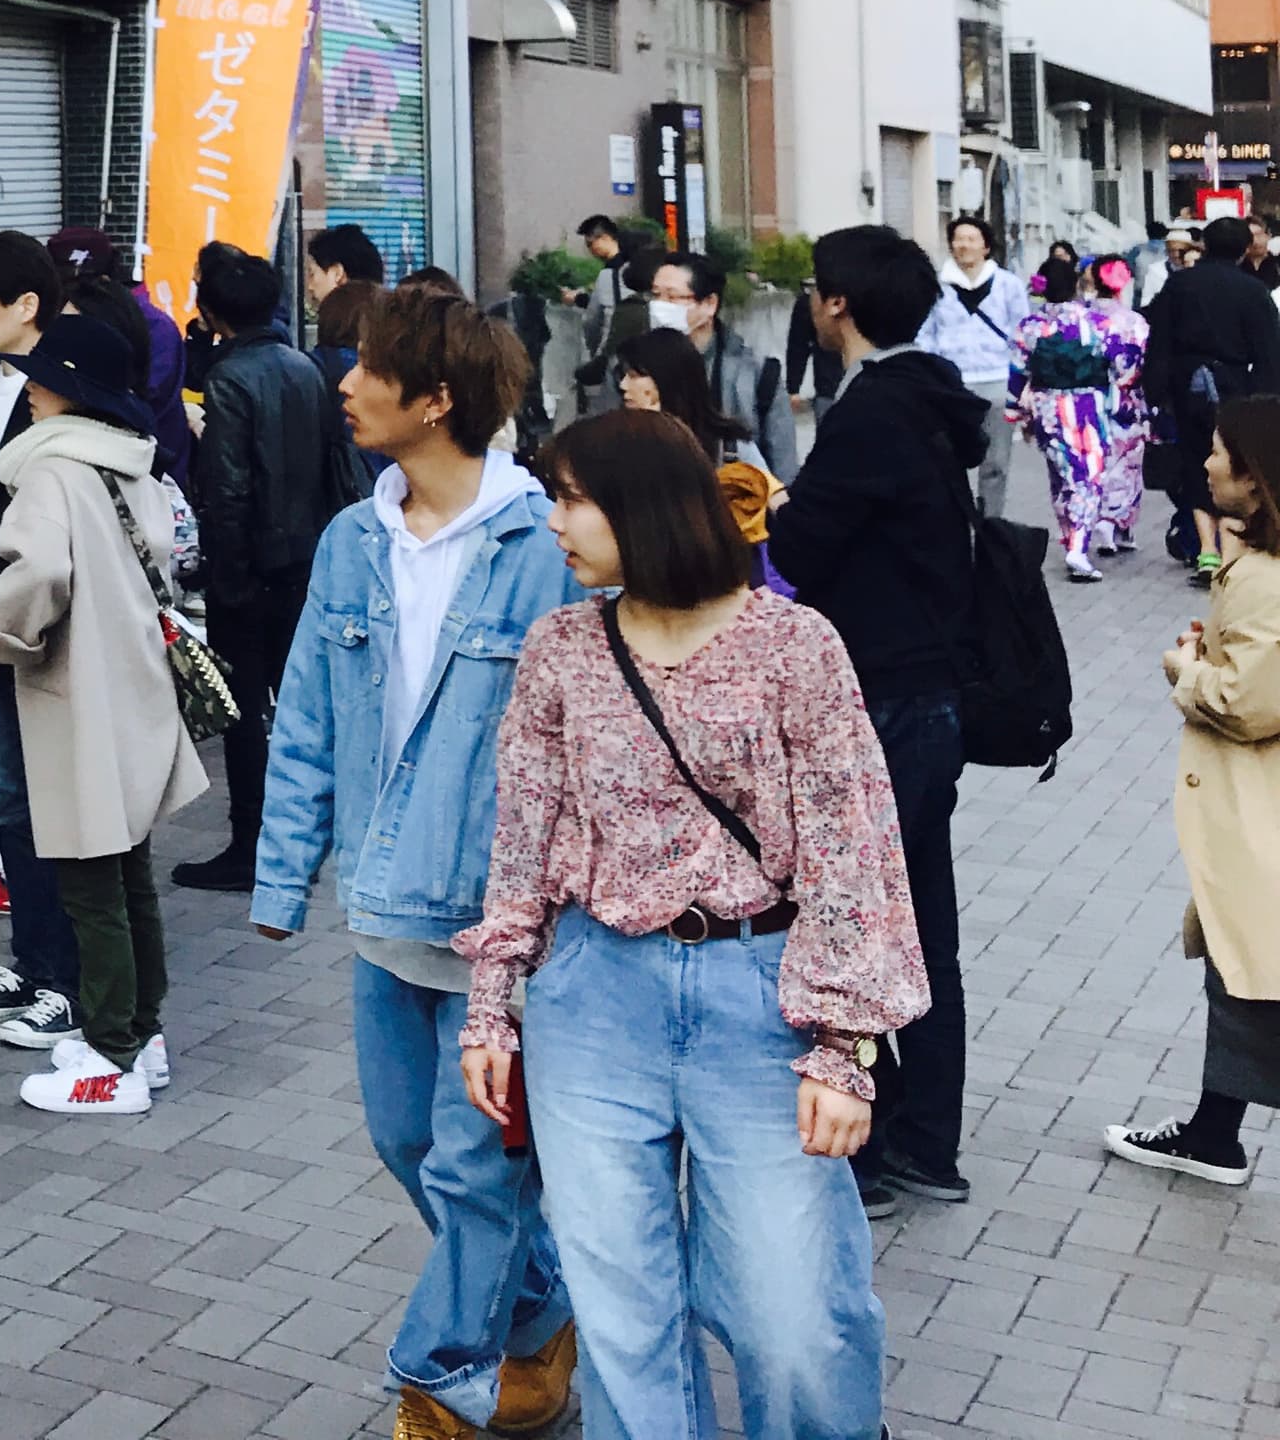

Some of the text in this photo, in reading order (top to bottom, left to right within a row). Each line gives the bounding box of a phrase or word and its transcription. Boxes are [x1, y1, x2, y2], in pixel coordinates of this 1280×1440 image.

[186, 31, 256, 312] ゼタミー
[68, 1073, 123, 1103] NIKE
